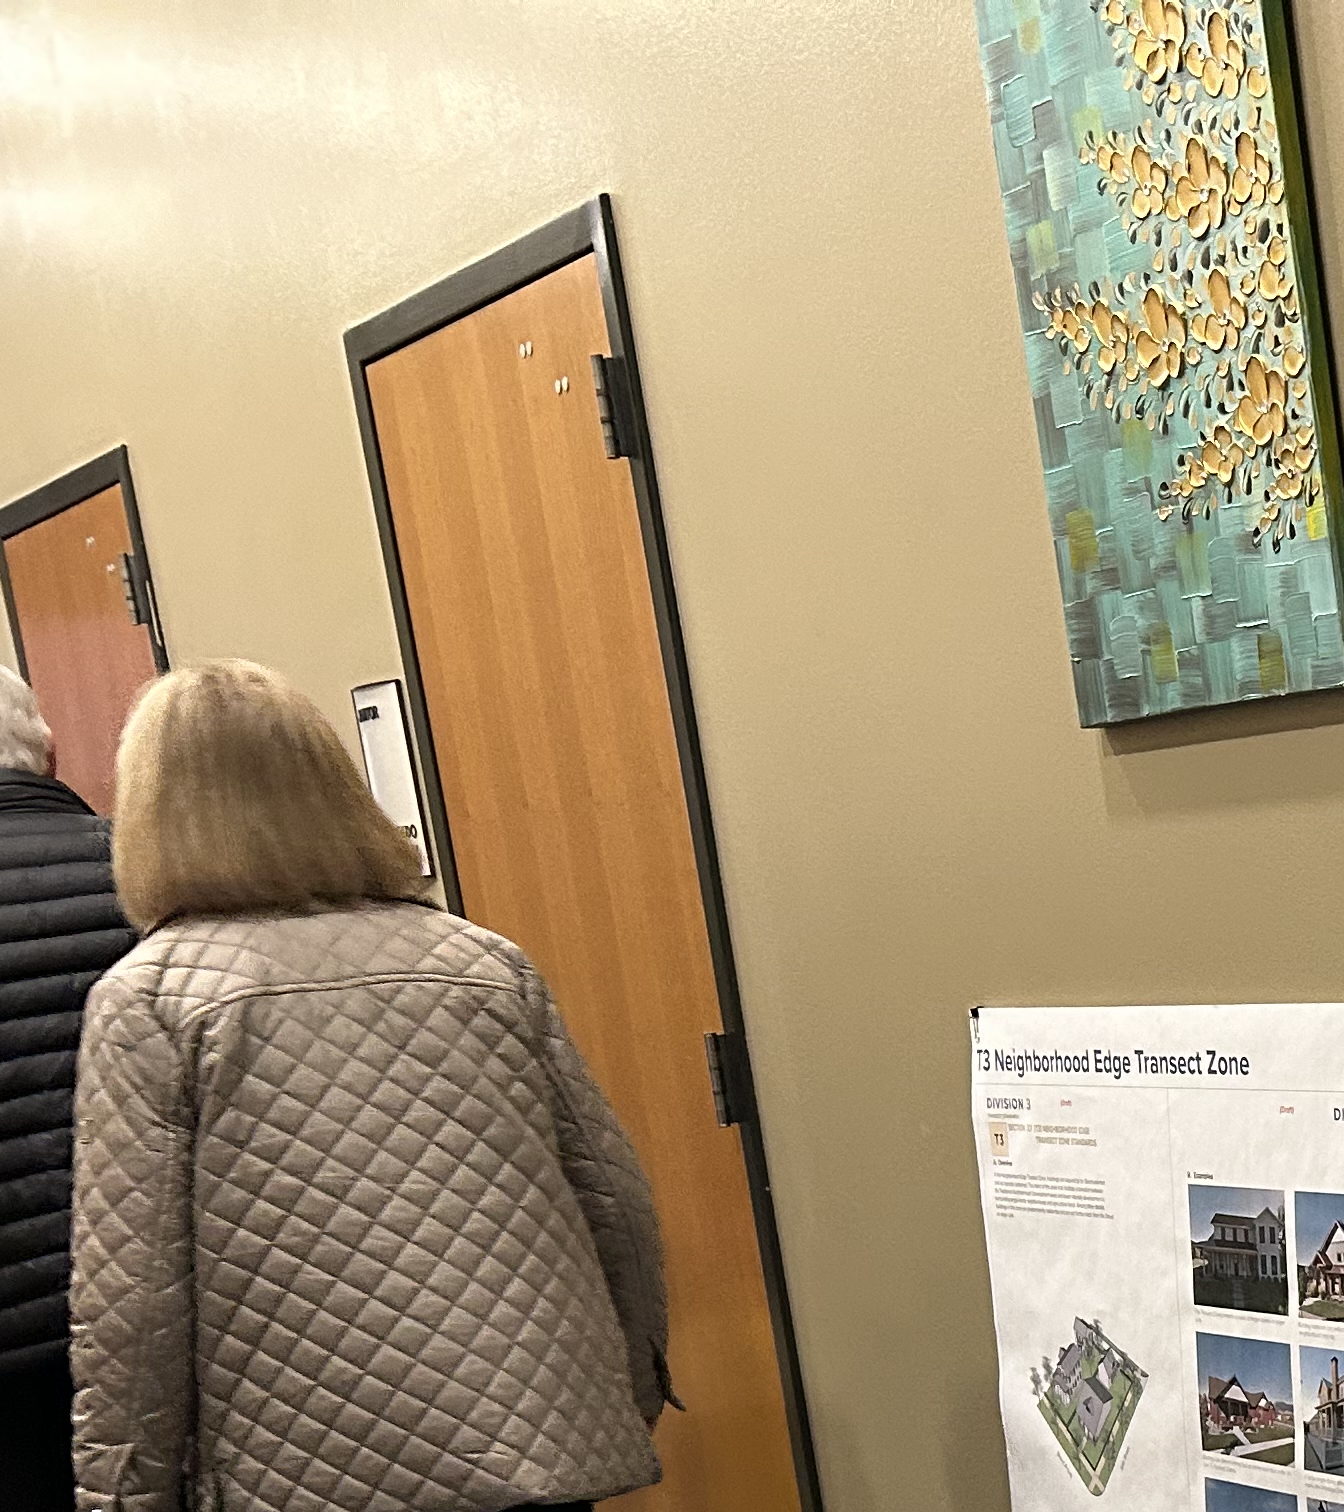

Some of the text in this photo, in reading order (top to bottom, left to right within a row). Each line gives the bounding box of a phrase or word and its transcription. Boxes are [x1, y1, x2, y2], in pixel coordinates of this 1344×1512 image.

[976, 1049, 1250, 1080] T3 Neighborhood Edge Transect Zone
[986, 1097, 1030, 1110] DIVISION 3
[994, 1133, 1005, 1146] T3
